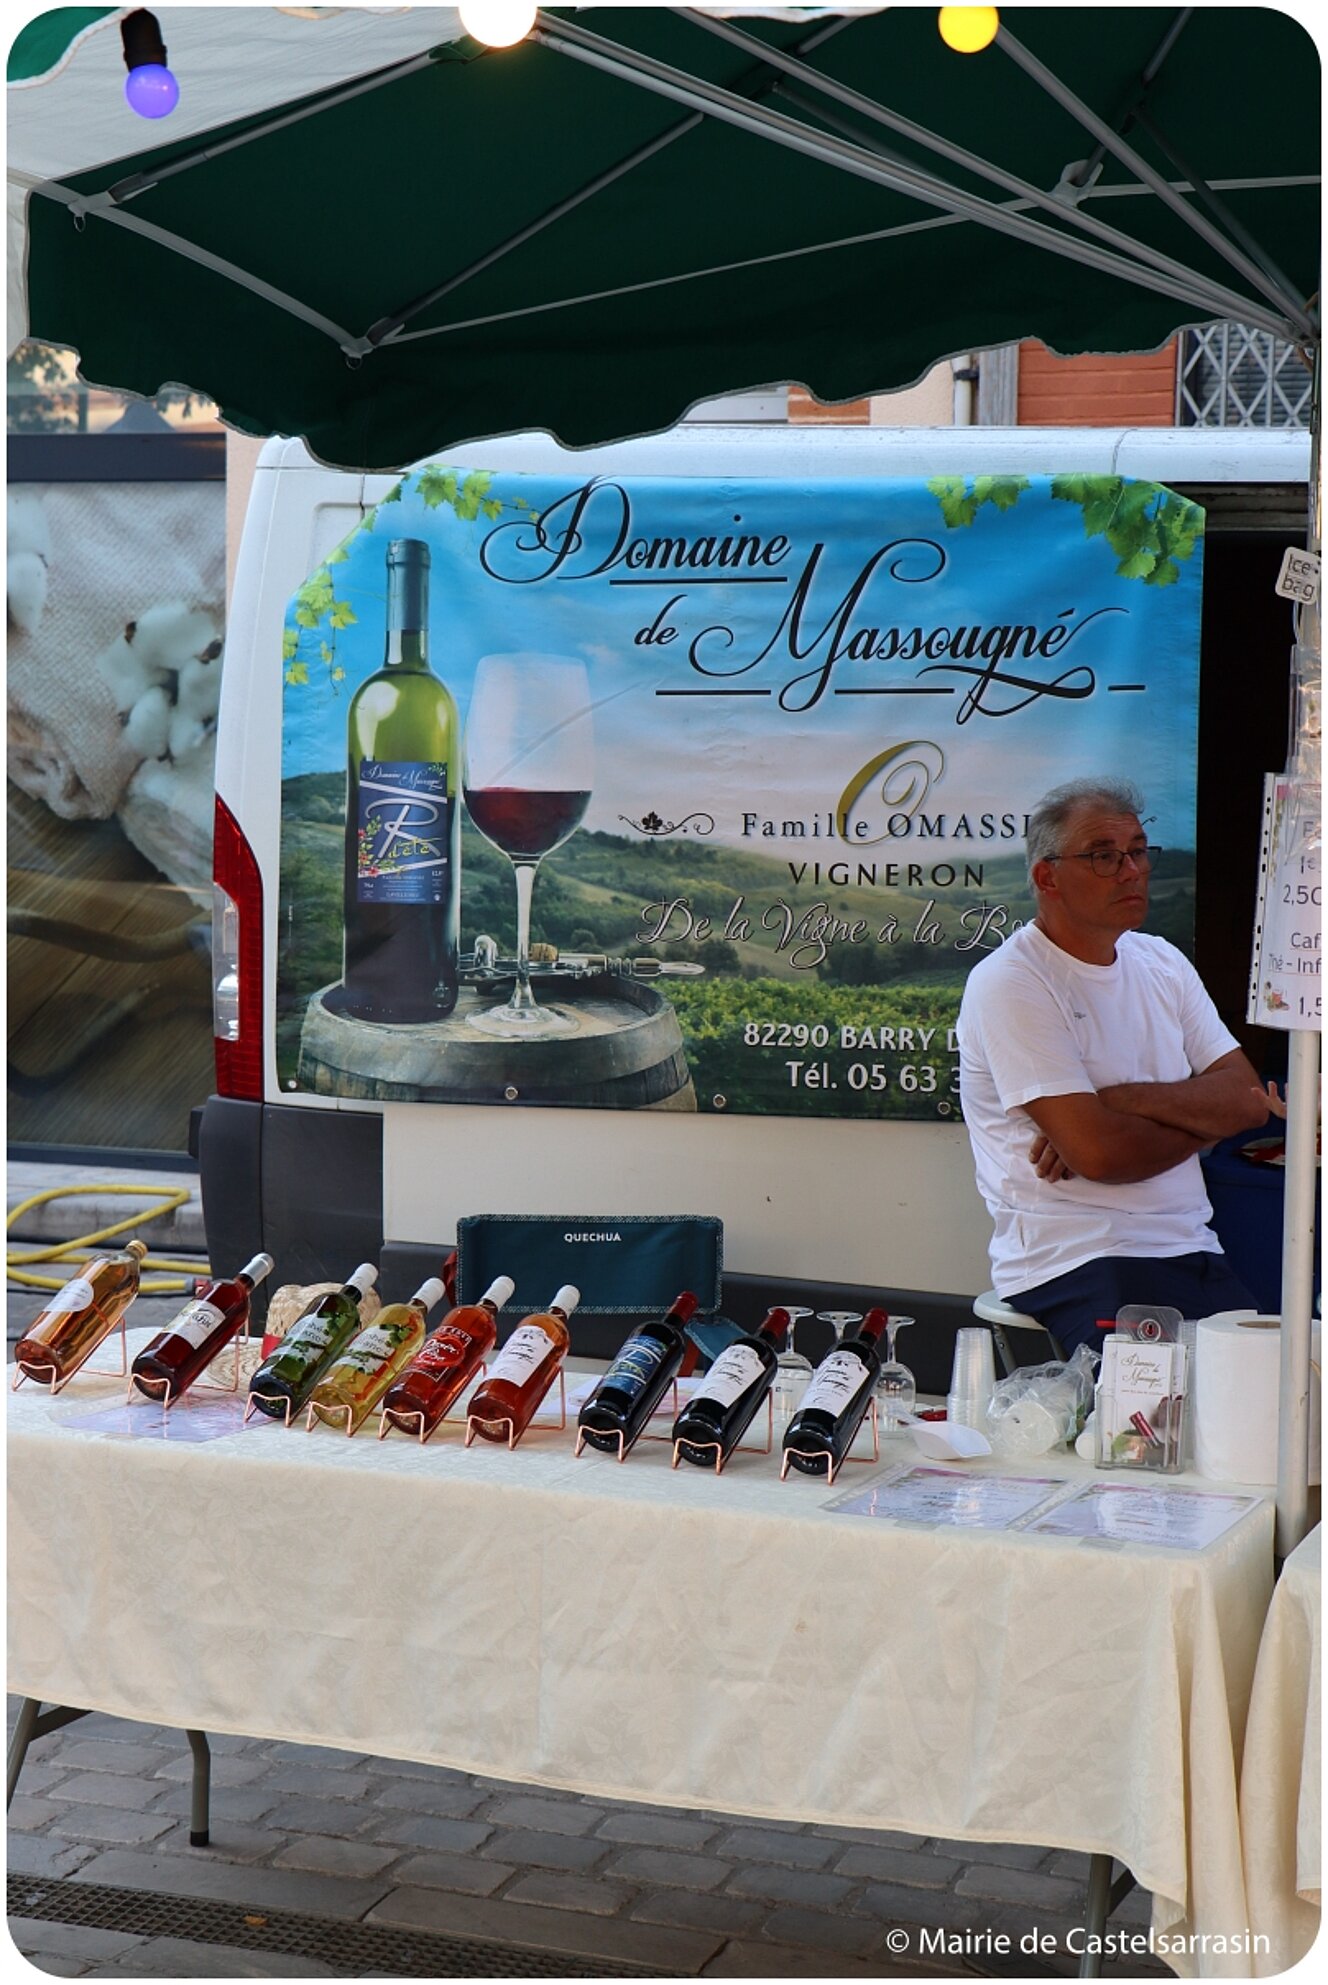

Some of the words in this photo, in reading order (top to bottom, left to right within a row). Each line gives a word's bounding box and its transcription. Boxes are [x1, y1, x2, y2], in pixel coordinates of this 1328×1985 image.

[479, 474, 792, 584] Domaine
[634, 594, 688, 645] de
[688, 538, 1130, 725] Massougné
[741, 812, 869, 838] Famille
[788, 862, 985, 887] VIGNERON
[635, 896, 712, 945] De
[723, 896, 755, 942] la
[761, 899, 870, 970] Vigne
[877, 914, 899, 943] à
[912, 899, 945, 943] la
[743, 1023, 830, 1048] 82290
[841, 1026, 936, 1051] BARRY
[785, 1060, 838, 1089] Tél.
[848, 1065, 888, 1091] 05
[899, 1066, 937, 1092] 63
[564, 1232, 622, 1243] QUECHUA
